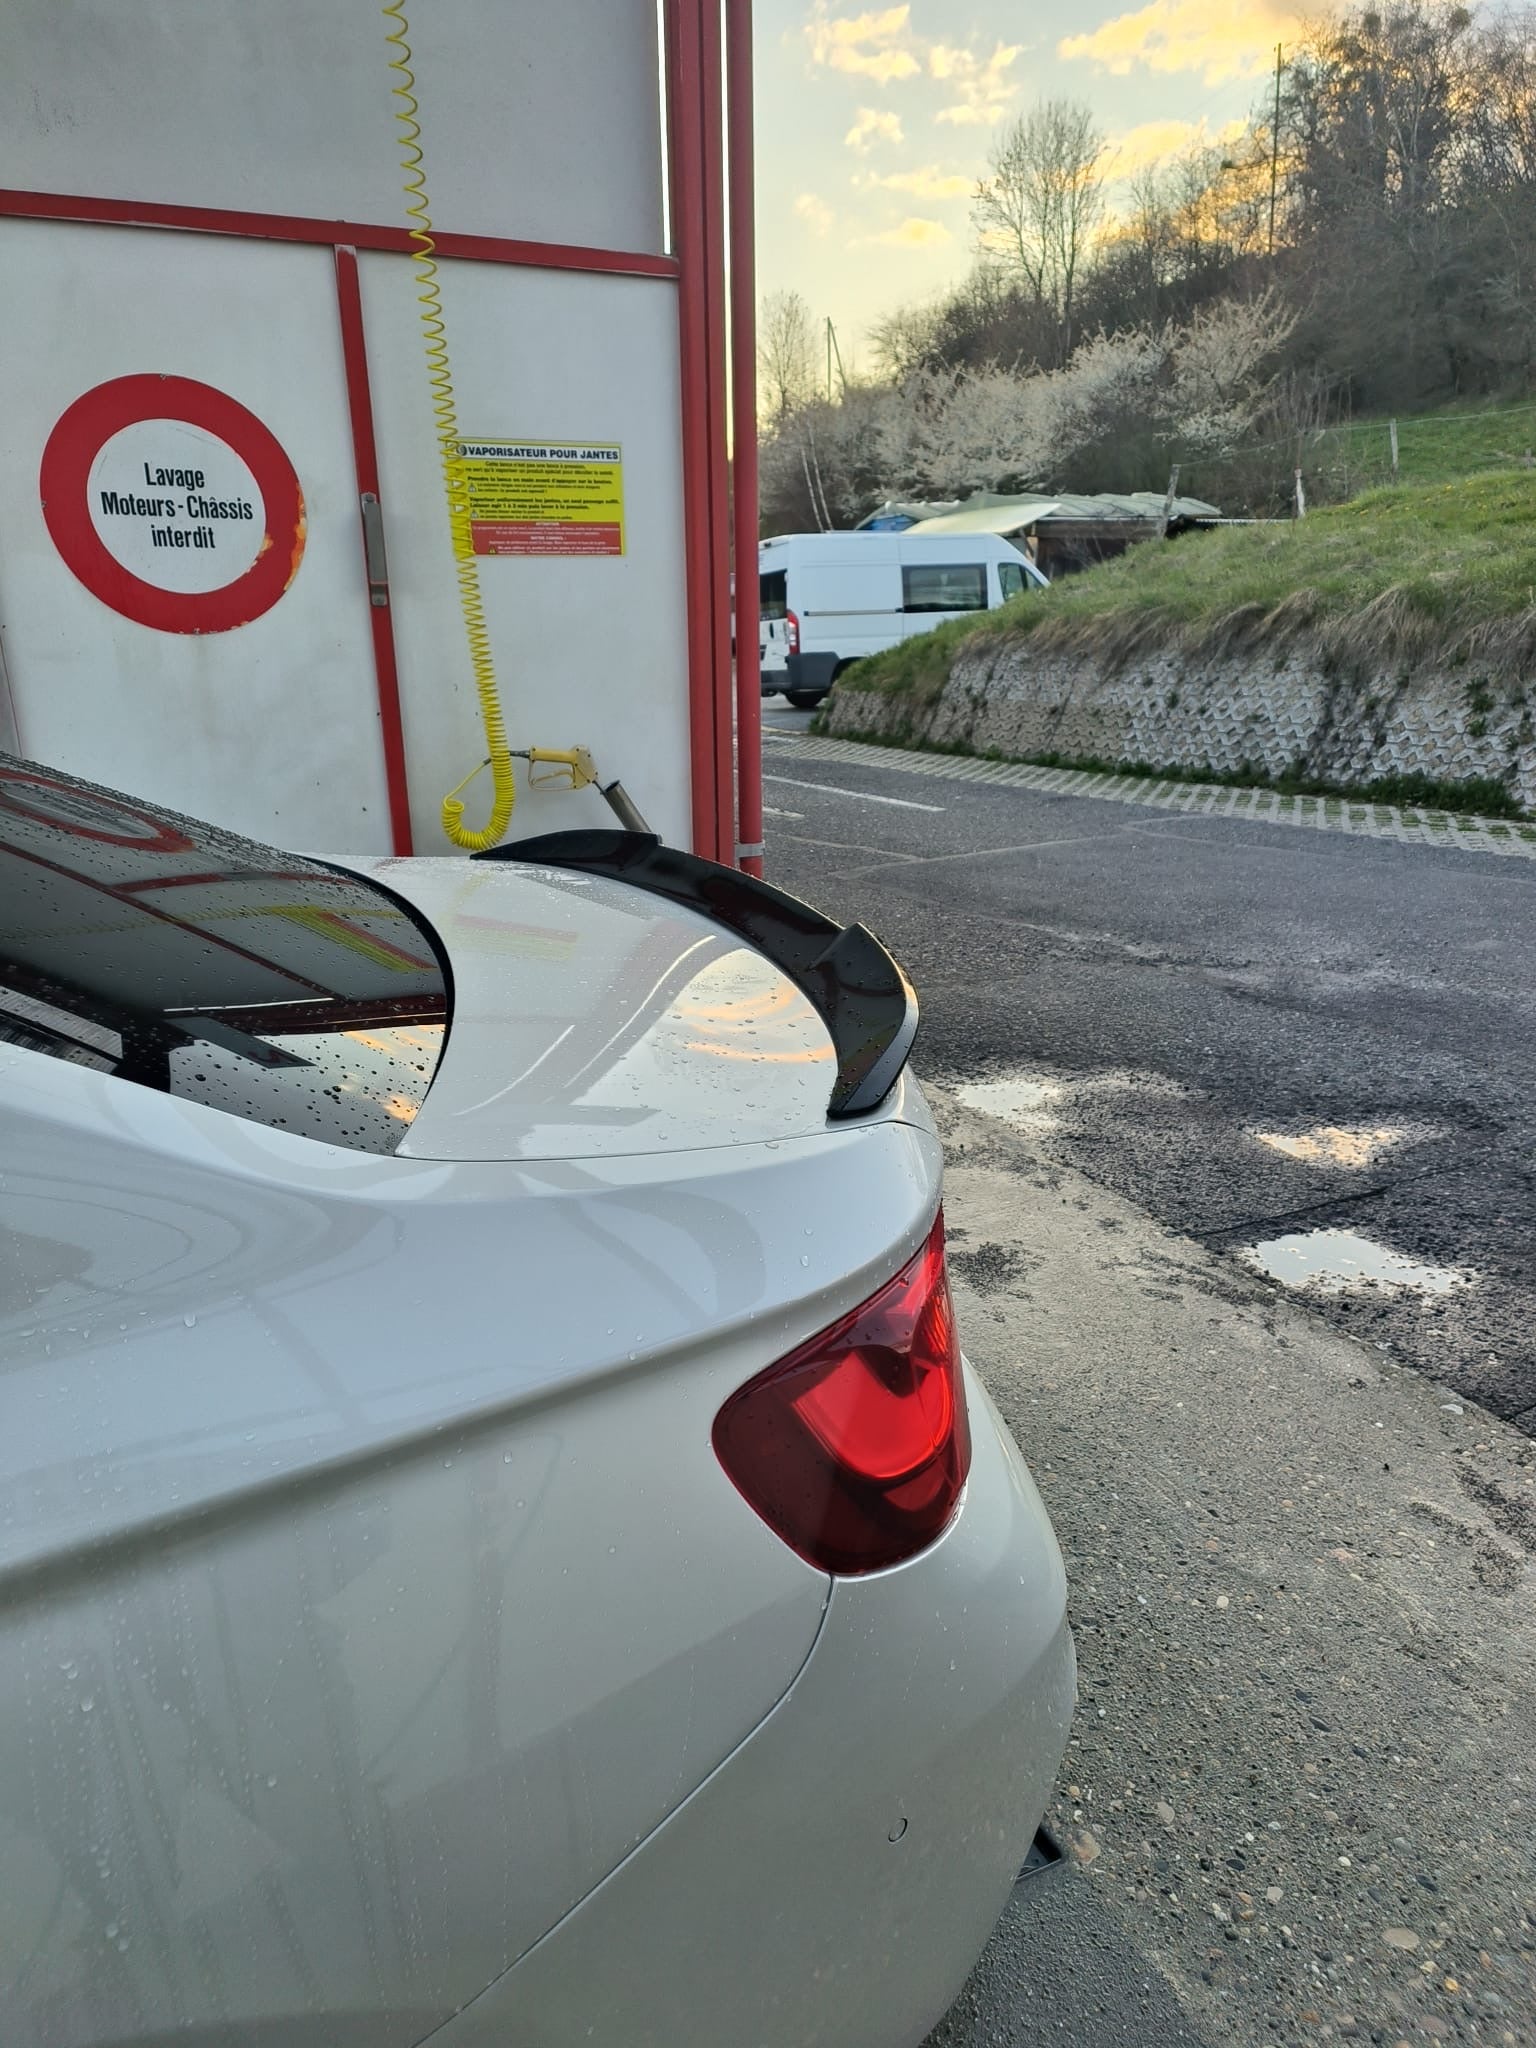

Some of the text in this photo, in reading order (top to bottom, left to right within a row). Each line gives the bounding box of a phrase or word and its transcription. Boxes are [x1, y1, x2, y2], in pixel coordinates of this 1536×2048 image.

[468, 447, 619, 460] VAPORISATEUR POUR JANTES
[144, 462, 205, 491] Lavage
[101, 491, 176, 517] Moteurs
[187, 495, 253, 520] Châssis
[151, 524, 216, 549] interdit
